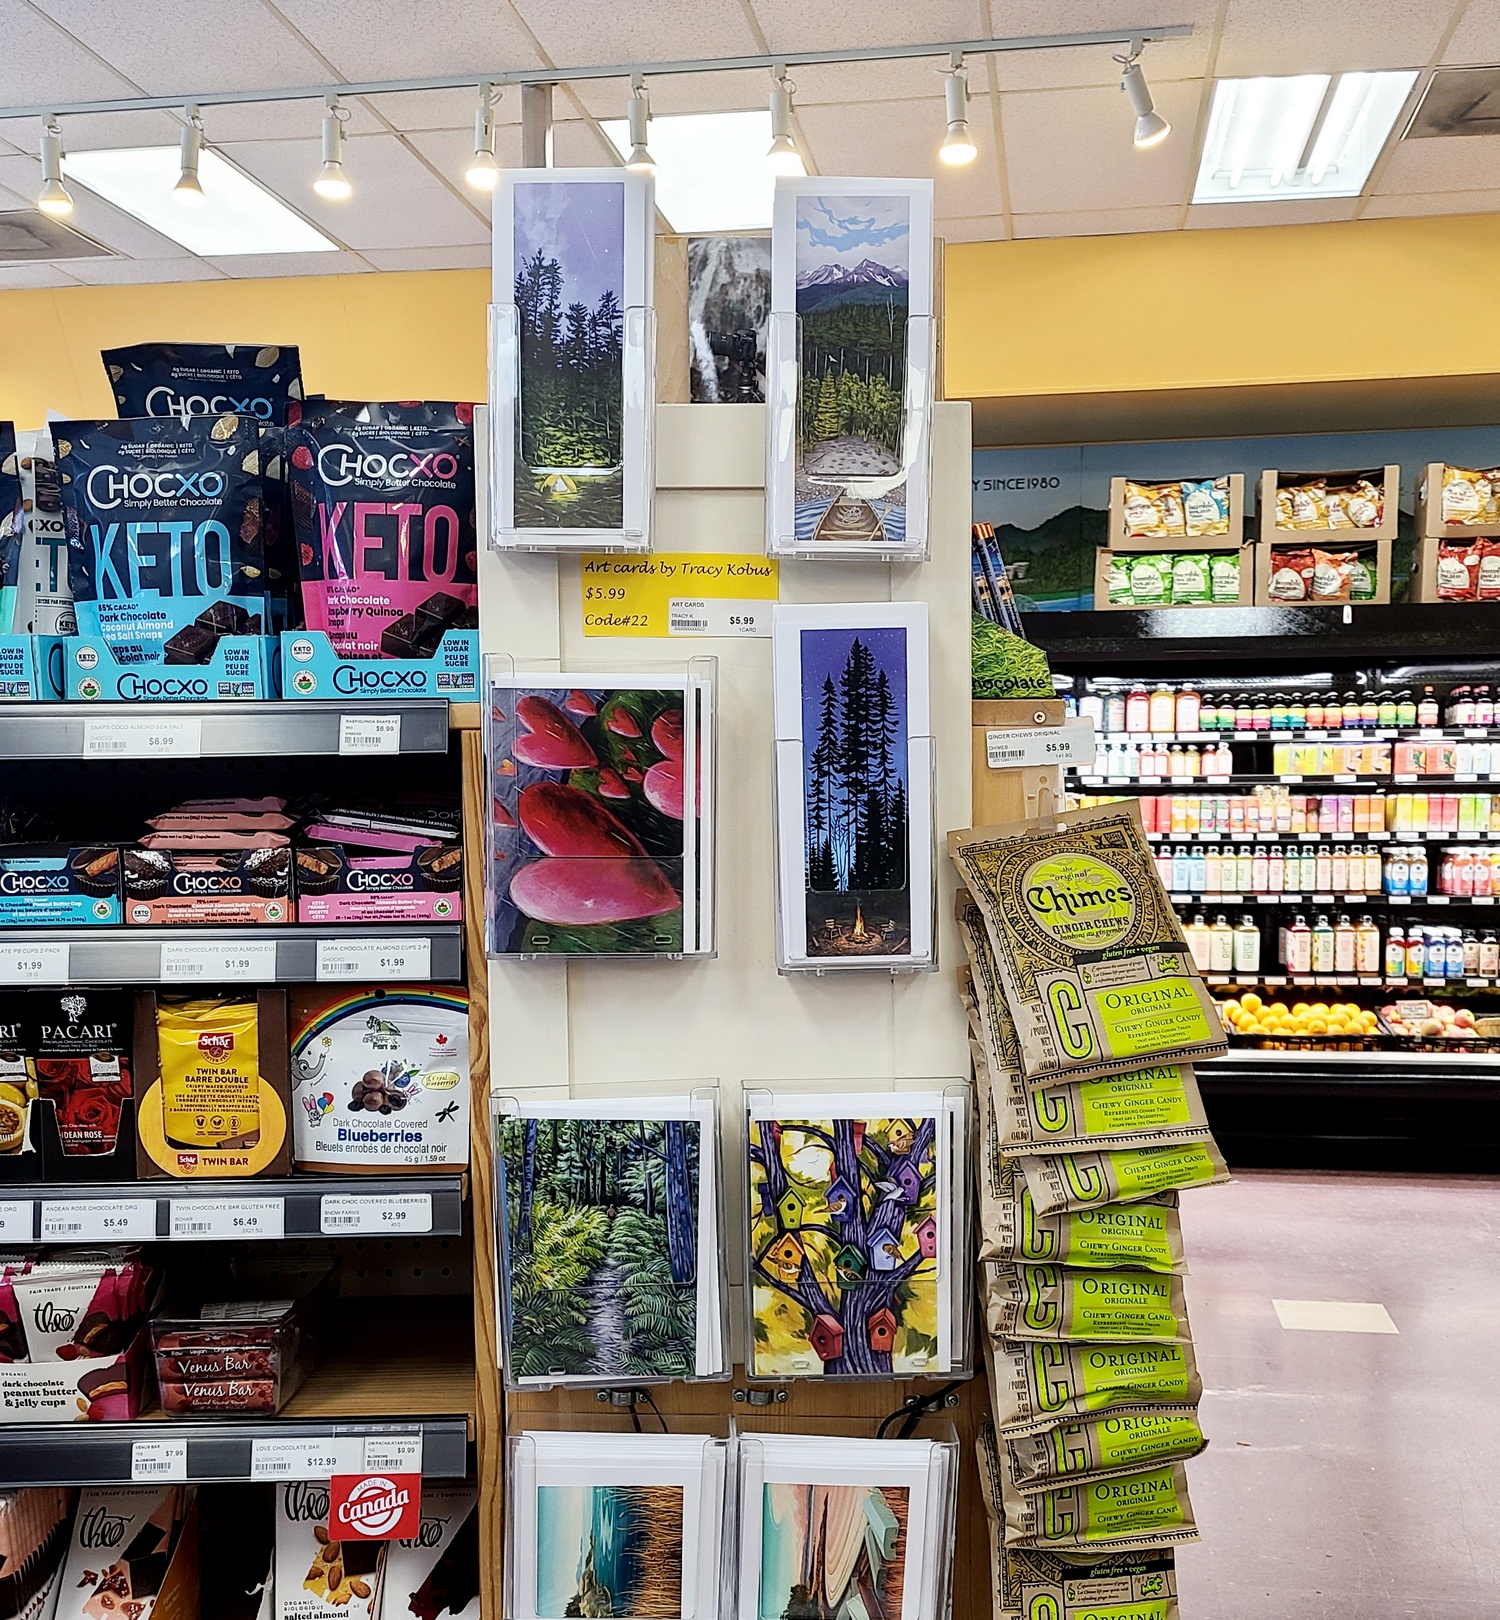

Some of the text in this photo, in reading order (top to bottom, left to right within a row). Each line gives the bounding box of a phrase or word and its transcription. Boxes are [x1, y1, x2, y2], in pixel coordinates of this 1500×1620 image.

[146, 386, 273, 419] CHOCXO
[318, 443, 458, 486] CHOCXO
[87, 465, 223, 509] CHOCXO
[355, 478, 456, 489] Simply Better Chocolate
[983, 479, 1025, 490] SINCE
[1028, 477, 1059, 489] 1980
[124, 497, 222, 510] Simply Better Chocolate
[319, 502, 459, 580] KETO
[89, 520, 232, 600] KETO
[585, 561, 773, 578] Art cards by Tracy Kobus
[585, 587, 625, 600] $5.99
[341, 596, 389, 605] Chocolate
[100, 611, 166, 622] Dark Chocolate
[366, 608, 403, 616] Quinoa
[137, 620, 173, 629] Almond
[585, 614, 648, 627] Code#22
[730, 616, 754, 625] $5.99
[118, 632, 162, 641] Salt Snaps
[332, 665, 427, 694] CHOCXO
[117, 673, 208, 700] CHOCXO
[149, 737, 173, 745] $6.99
[1046, 743, 1070, 752] $5.99
[1, 872, 69, 894] CHOCXO
[174, 873, 241, 894] CHOCXO
[347, 870, 413, 891] CHOCXO
[1027, 886, 1132, 916] Chimes
[1052, 916, 1129, 934] GINGER CHEWS
[1102, 950, 1123, 960] gluten
[1124, 948, 1136, 958] free
[17, 962, 42, 970] $1.99
[225, 960, 249, 968] $1.99
[380, 958, 404, 966] $1.99
[1105, 987, 1192, 1008] ORIGINAL
[1131, 1003, 1172, 1015] ORIGINALE
[1115, 1014, 1200, 1033] CHEWY GINGER CANDY
[41, 1025, 112, 1039] PACARI
[200, 1035, 231, 1048] Schär
[196, 1068, 218, 1076] TWIN
[186, 1075, 249, 1083] BARRE DOUBLE
[1092, 1096, 1182, 1110] CHEWY GINGER CANDY
[333, 1118, 428, 1128] Dark Chocolate Covered
[338, 1129, 423, 1142] Blueberries
[316, 1142, 447, 1154] Bleuets enrobés de chocolat noir
[203, 1156, 249, 1166] TWIN BAR
[104, 1218, 128, 1227] $5.49
[233, 1218, 258, 1226] $6.49
[382, 1212, 406, 1221] $2.99
[1078, 1211, 1163, 1230] ORIGINAL
[1101, 1227, 1145, 1237] ORIGINALE
[1082, 1279, 1168, 1297] ORIGINAL
[178, 1356, 252, 1374] Venus Bar
[1090, 1349, 1181, 1369] ORIGINAL
[1114, 1366, 1156, 1376] ORIGINALE
[2, 1380, 21, 1388] dark
[183, 1381, 254, 1397] Venus Bar
[3, 1387, 78, 1399] peanut butter
[5, 1399, 66, 1409] & jelly cups
[307, 1458, 336, 1467] $12.99
[357, 1480, 376, 1491] MADE
[339, 1489, 409, 1523] Canada
[314, 1610, 349, 1620] almond
